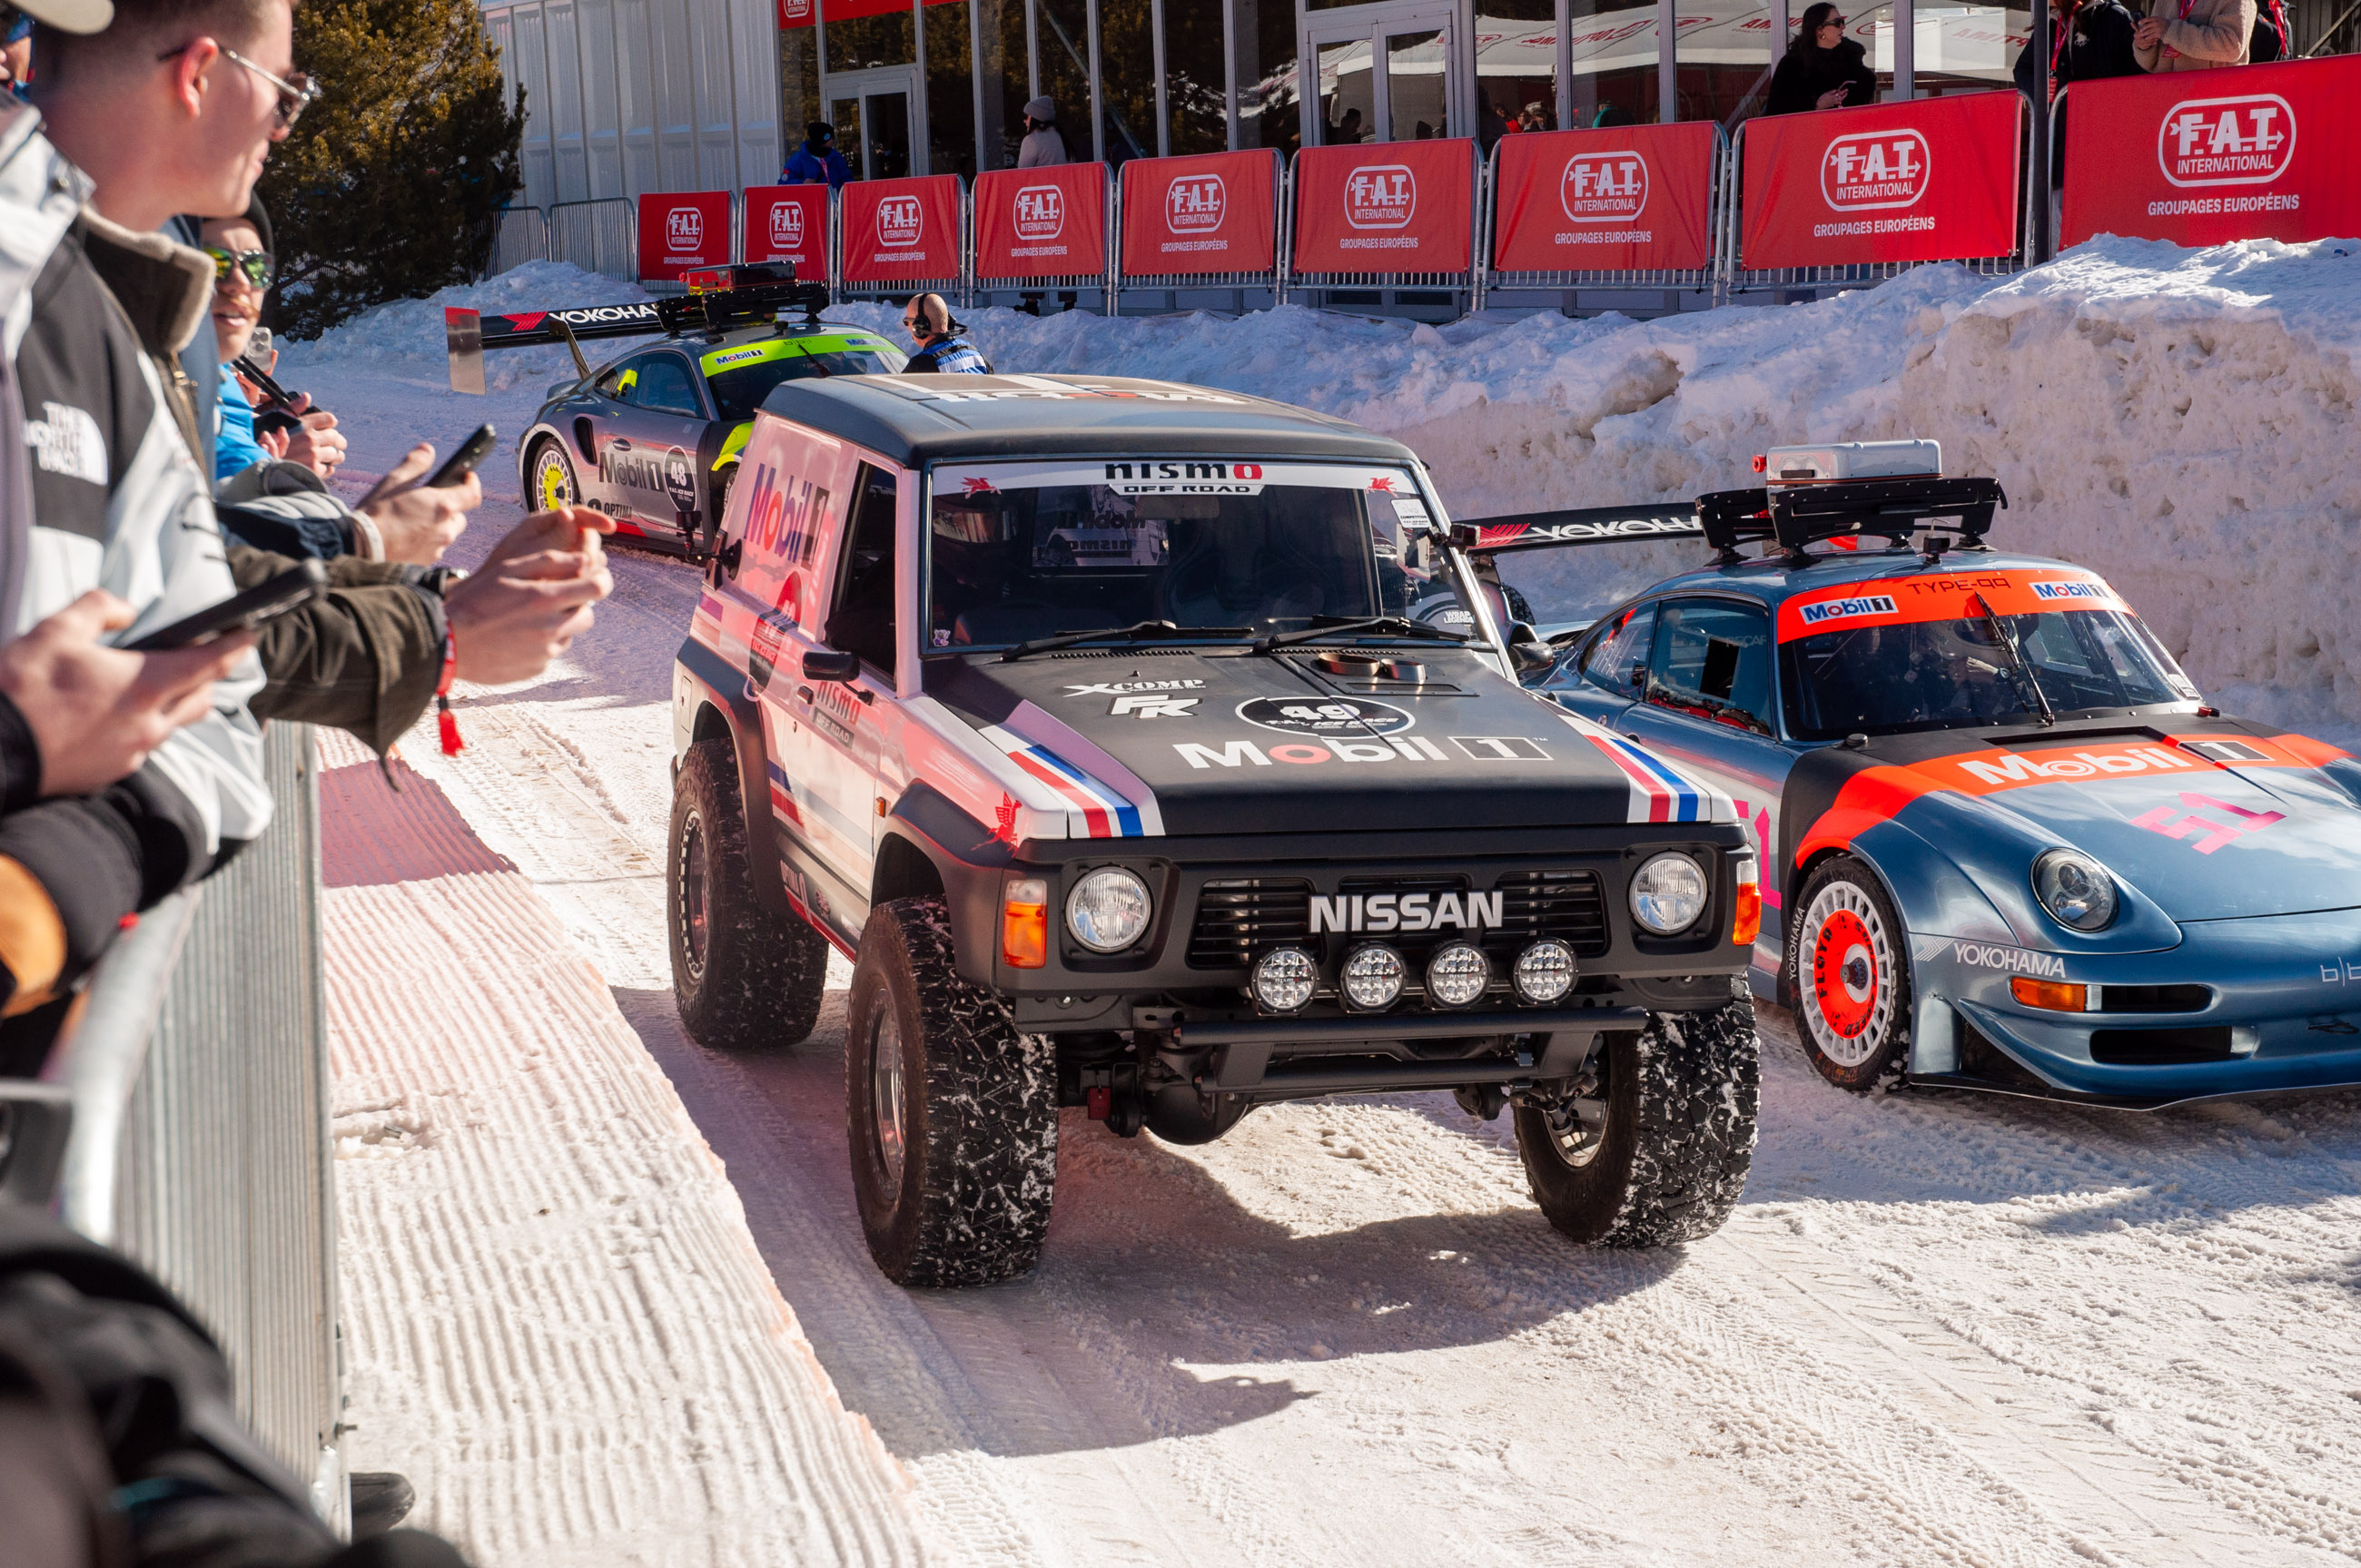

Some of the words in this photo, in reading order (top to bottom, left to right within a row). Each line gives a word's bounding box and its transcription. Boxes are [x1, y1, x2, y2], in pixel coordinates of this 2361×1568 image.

[2178, 107, 2278, 156] F.A.T.
[1836, 141, 1916, 184] F.A.T.
[2177, 154, 2275, 174] INTERNATIONAL
[1354, 174, 1408, 206] F.A.T.
[1574, 162, 1639, 198] F.A.T.
[1836, 182, 1914, 200] INTERNATIONAL
[1020, 193, 1059, 221] F.A.T.
[1173, 182, 1220, 212] F.A.T.
[1574, 198, 1637, 212] INTERNATIONAL
[2148, 199, 2222, 215] GROUPAGES
[2224, 192, 2300, 212] EUROPÉENS
[774, 209, 800, 232] F.A.T.
[883, 203, 917, 228] F.A.T.
[1173, 213, 1216, 225] INTERNATIONAL
[1354, 206, 1406, 220] INTERNATIONAL
[671, 214, 699, 236] F.A.T.
[884, 229, 916, 239] INTERNATIONAL
[1021, 221, 1057, 232] INTERNATIONAL
[1555, 232, 1604, 244] GROUPAGES
[1605, 228, 1652, 243] EUROPÉENS
[1813, 221, 1872, 237] GROUPAGES
[1874, 215, 1935, 233] EUROPÉENS
[1012, 246, 1038, 257] GROUPAGES
[1039, 244, 1068, 256] EUROPÉENS
[1161, 240, 1193, 252] GROUPAGES
[1193, 237, 1228, 251] EUROPÉENS
[1339, 237, 1378, 249] GROUPAGES
[1379, 234, 1418, 249] EUROPÉENS
[874, 253, 898, 262] GROUPAGES
[899, 250, 925, 261] EUROPÉENS
[548, 303, 657, 324] YOKOHA
[716, 351, 751, 365] Mobil
[599, 452, 647, 489] Mobil
[670, 461, 687, 487] 48
[604, 502, 633, 520] OPTIMA
[743, 462, 813, 563] Mobil
[2034, 583, 2092, 599] Mobil
[1804, 597, 1872, 621] Mobil
[1279, 704, 1360, 720] 49
[830, 724, 850, 743] ROAD
[1172, 736, 1450, 769] Mobil
[1957, 747, 2194, 785] Mobil
[1309, 891, 1503, 934] NISSAN
[1788, 906, 1805, 981] YOKOHAMA
[1816, 926, 1832, 1000] FLOYD
[1953, 942, 2066, 979] YOKOHAMA
